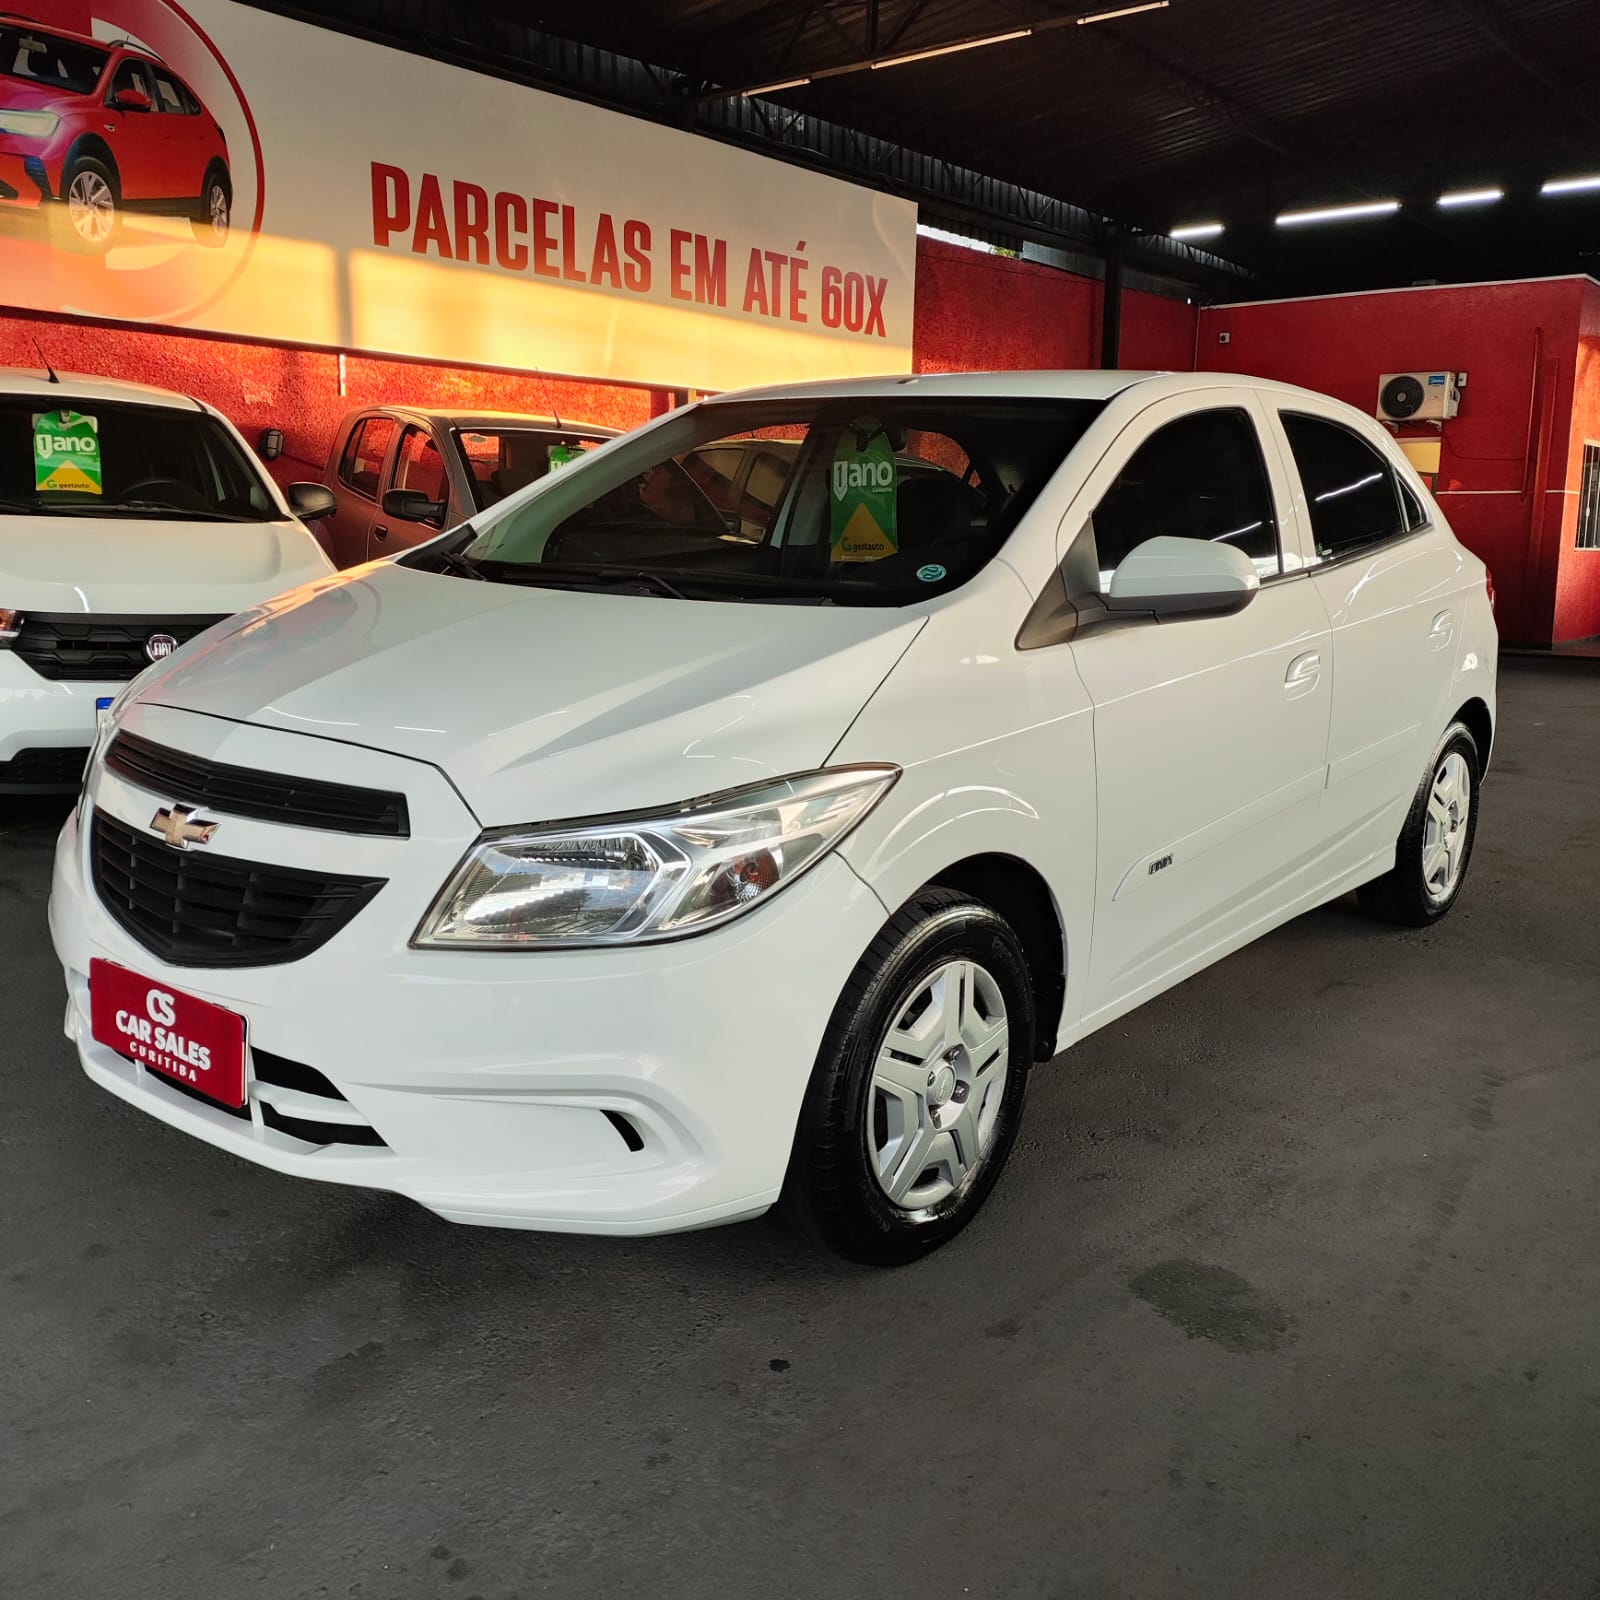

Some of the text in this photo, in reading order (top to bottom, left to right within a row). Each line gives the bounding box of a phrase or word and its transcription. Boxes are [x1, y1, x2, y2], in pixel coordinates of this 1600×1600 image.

[371, 161, 889, 338] PARCELAS EM ATÉ 60X
[53, 436, 96, 452] ano
[848, 461, 893, 488] ano
[853, 542, 885, 553] gestauto
[153, 642, 172, 656] FIAT
[146, 989, 176, 1027] CS
[115, 1010, 211, 1071] CAR SALES
[129, 1041, 197, 1082] CURITIBA
